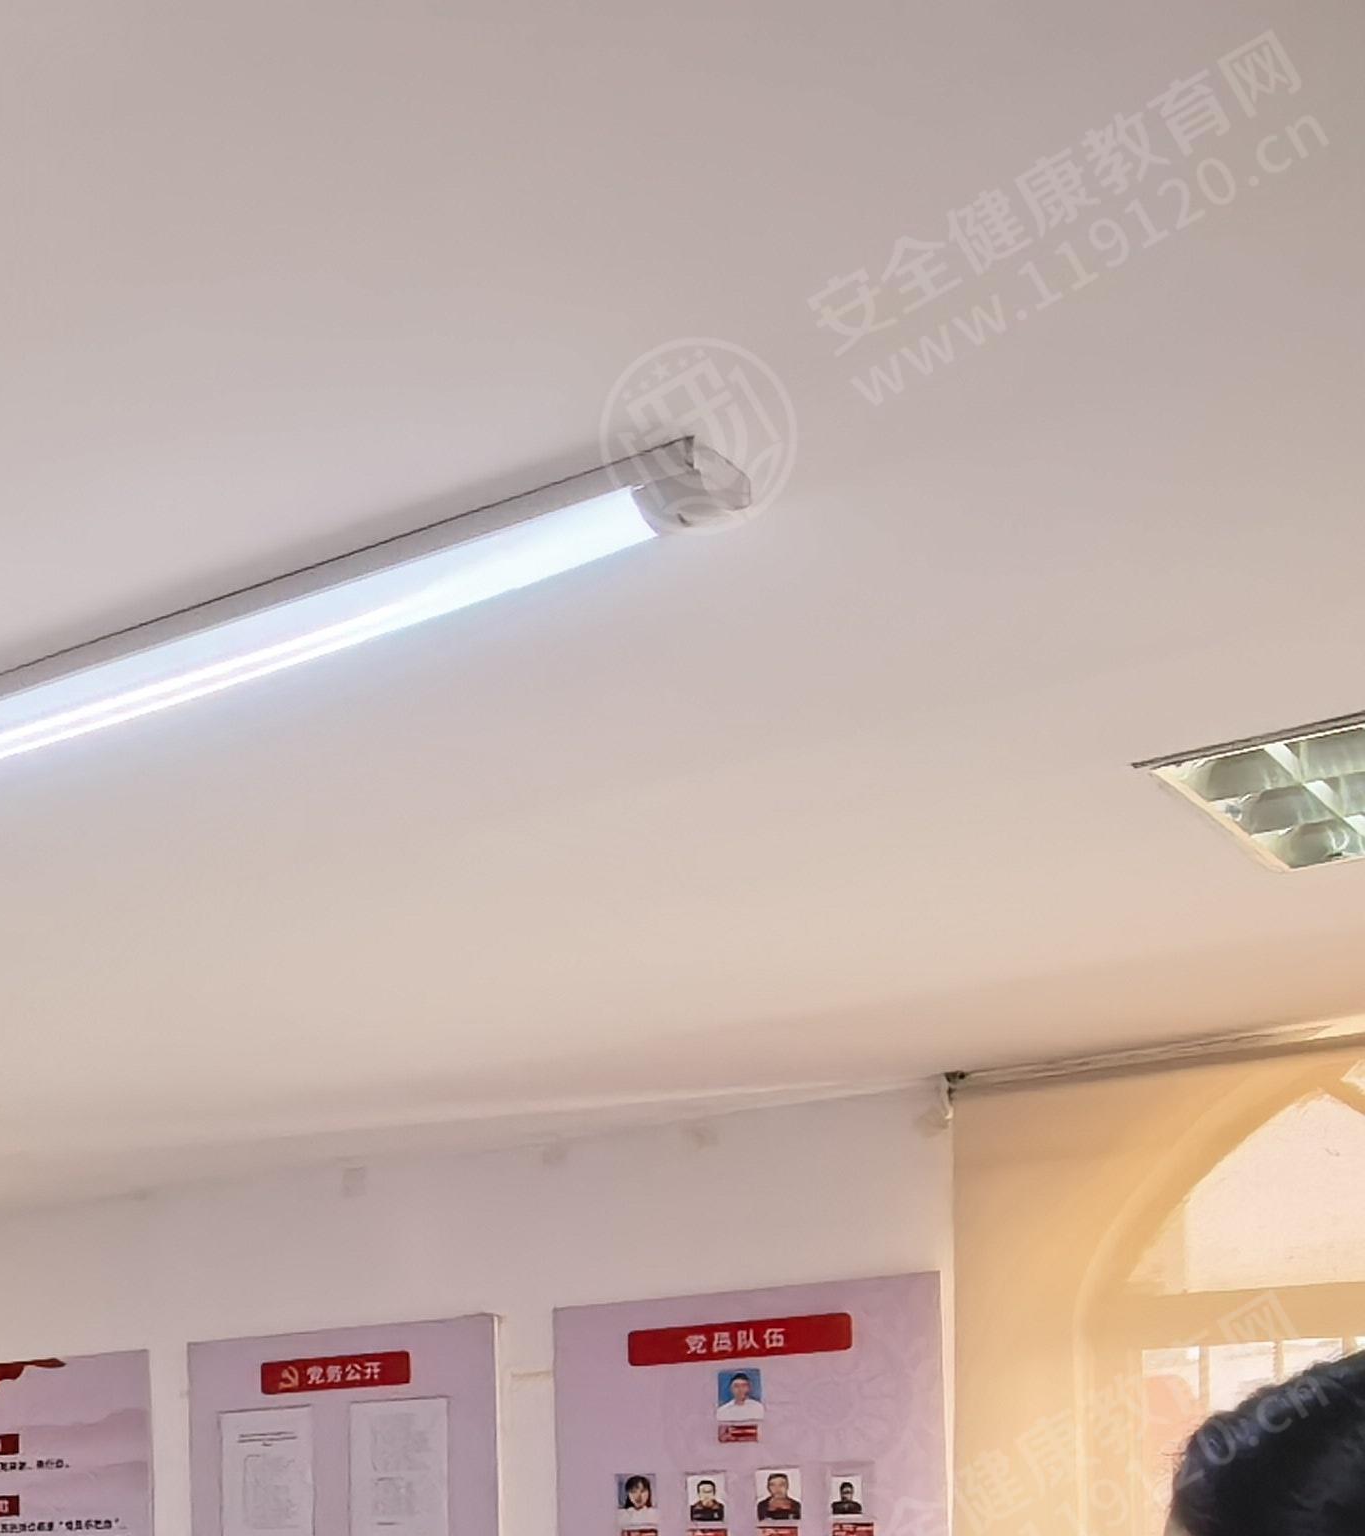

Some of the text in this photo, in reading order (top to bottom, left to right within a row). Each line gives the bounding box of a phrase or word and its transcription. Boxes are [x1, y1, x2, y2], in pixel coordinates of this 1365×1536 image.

[685, 1328, 786, 1355] 党员队伍
[306, 1361, 382, 1386] 党务公开
